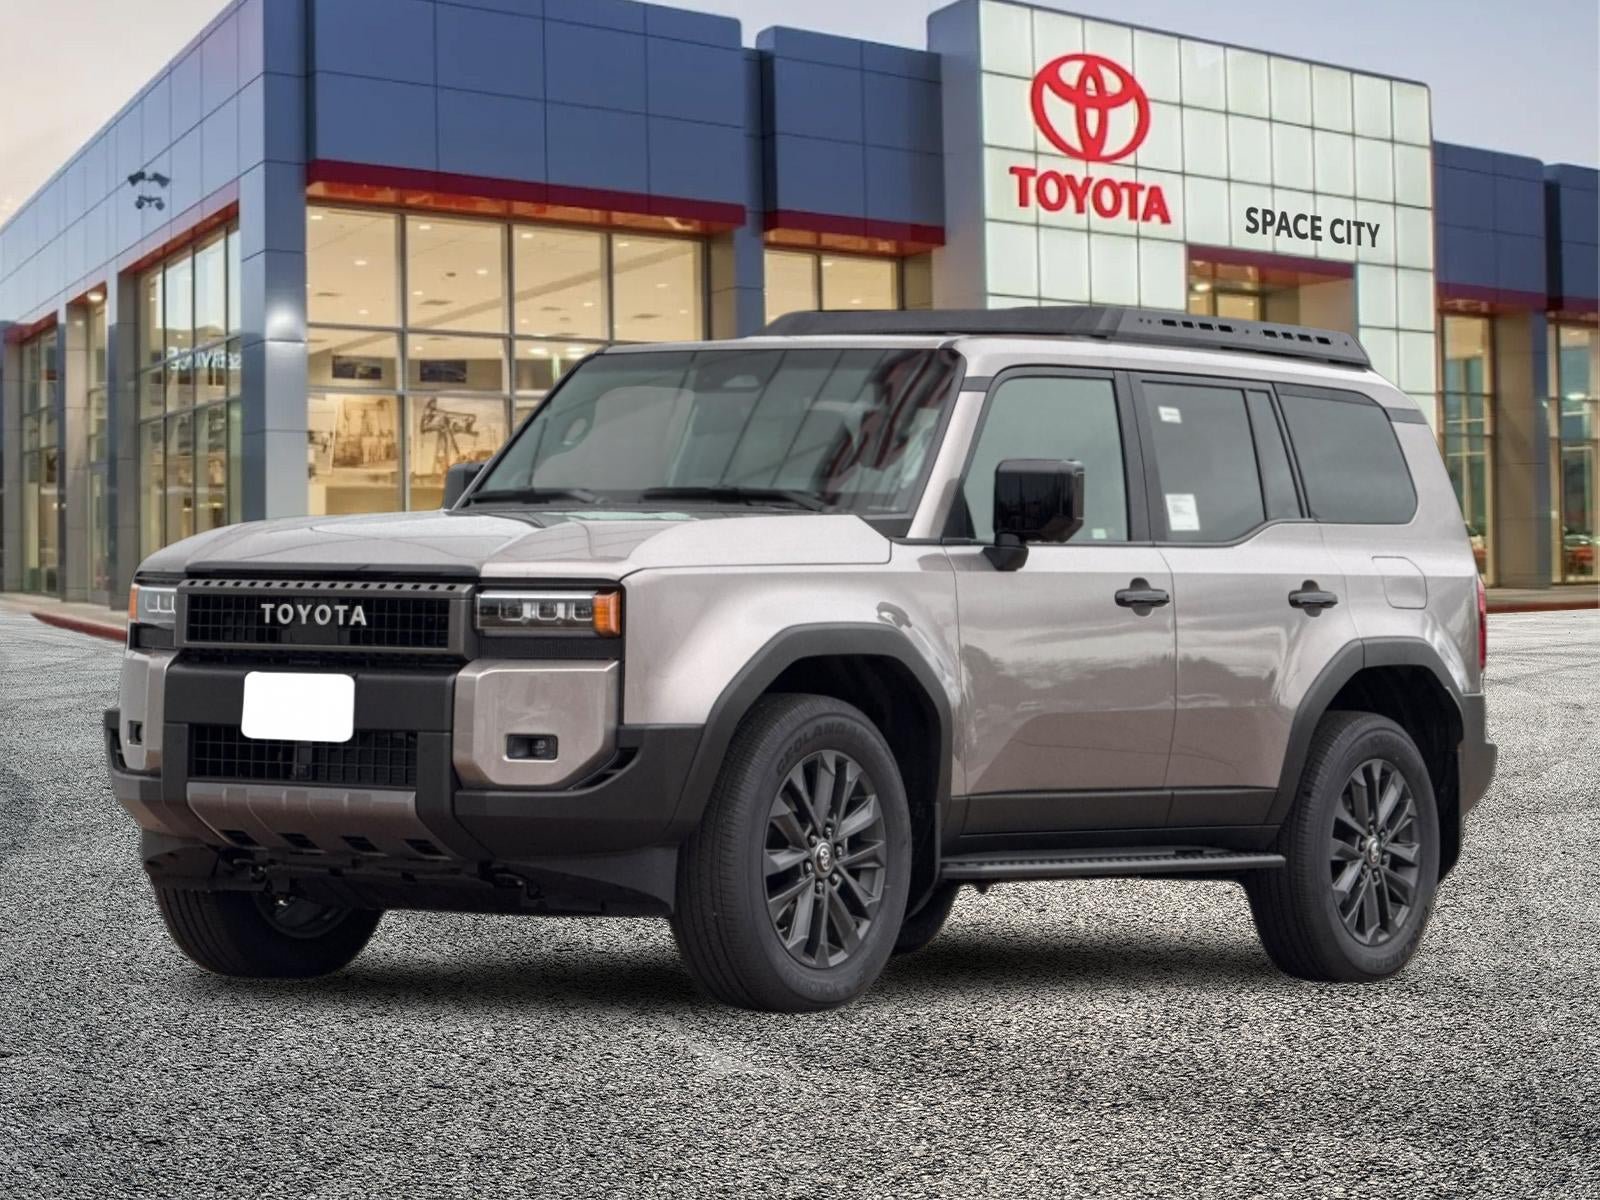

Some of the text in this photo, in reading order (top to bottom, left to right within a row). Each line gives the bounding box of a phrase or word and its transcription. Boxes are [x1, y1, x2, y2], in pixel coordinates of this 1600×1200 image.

[1009, 166, 1171, 225] TOYOTA
[1245, 206, 1381, 248] SPACE CITY
[260, 603, 368, 626] TOYOTA
